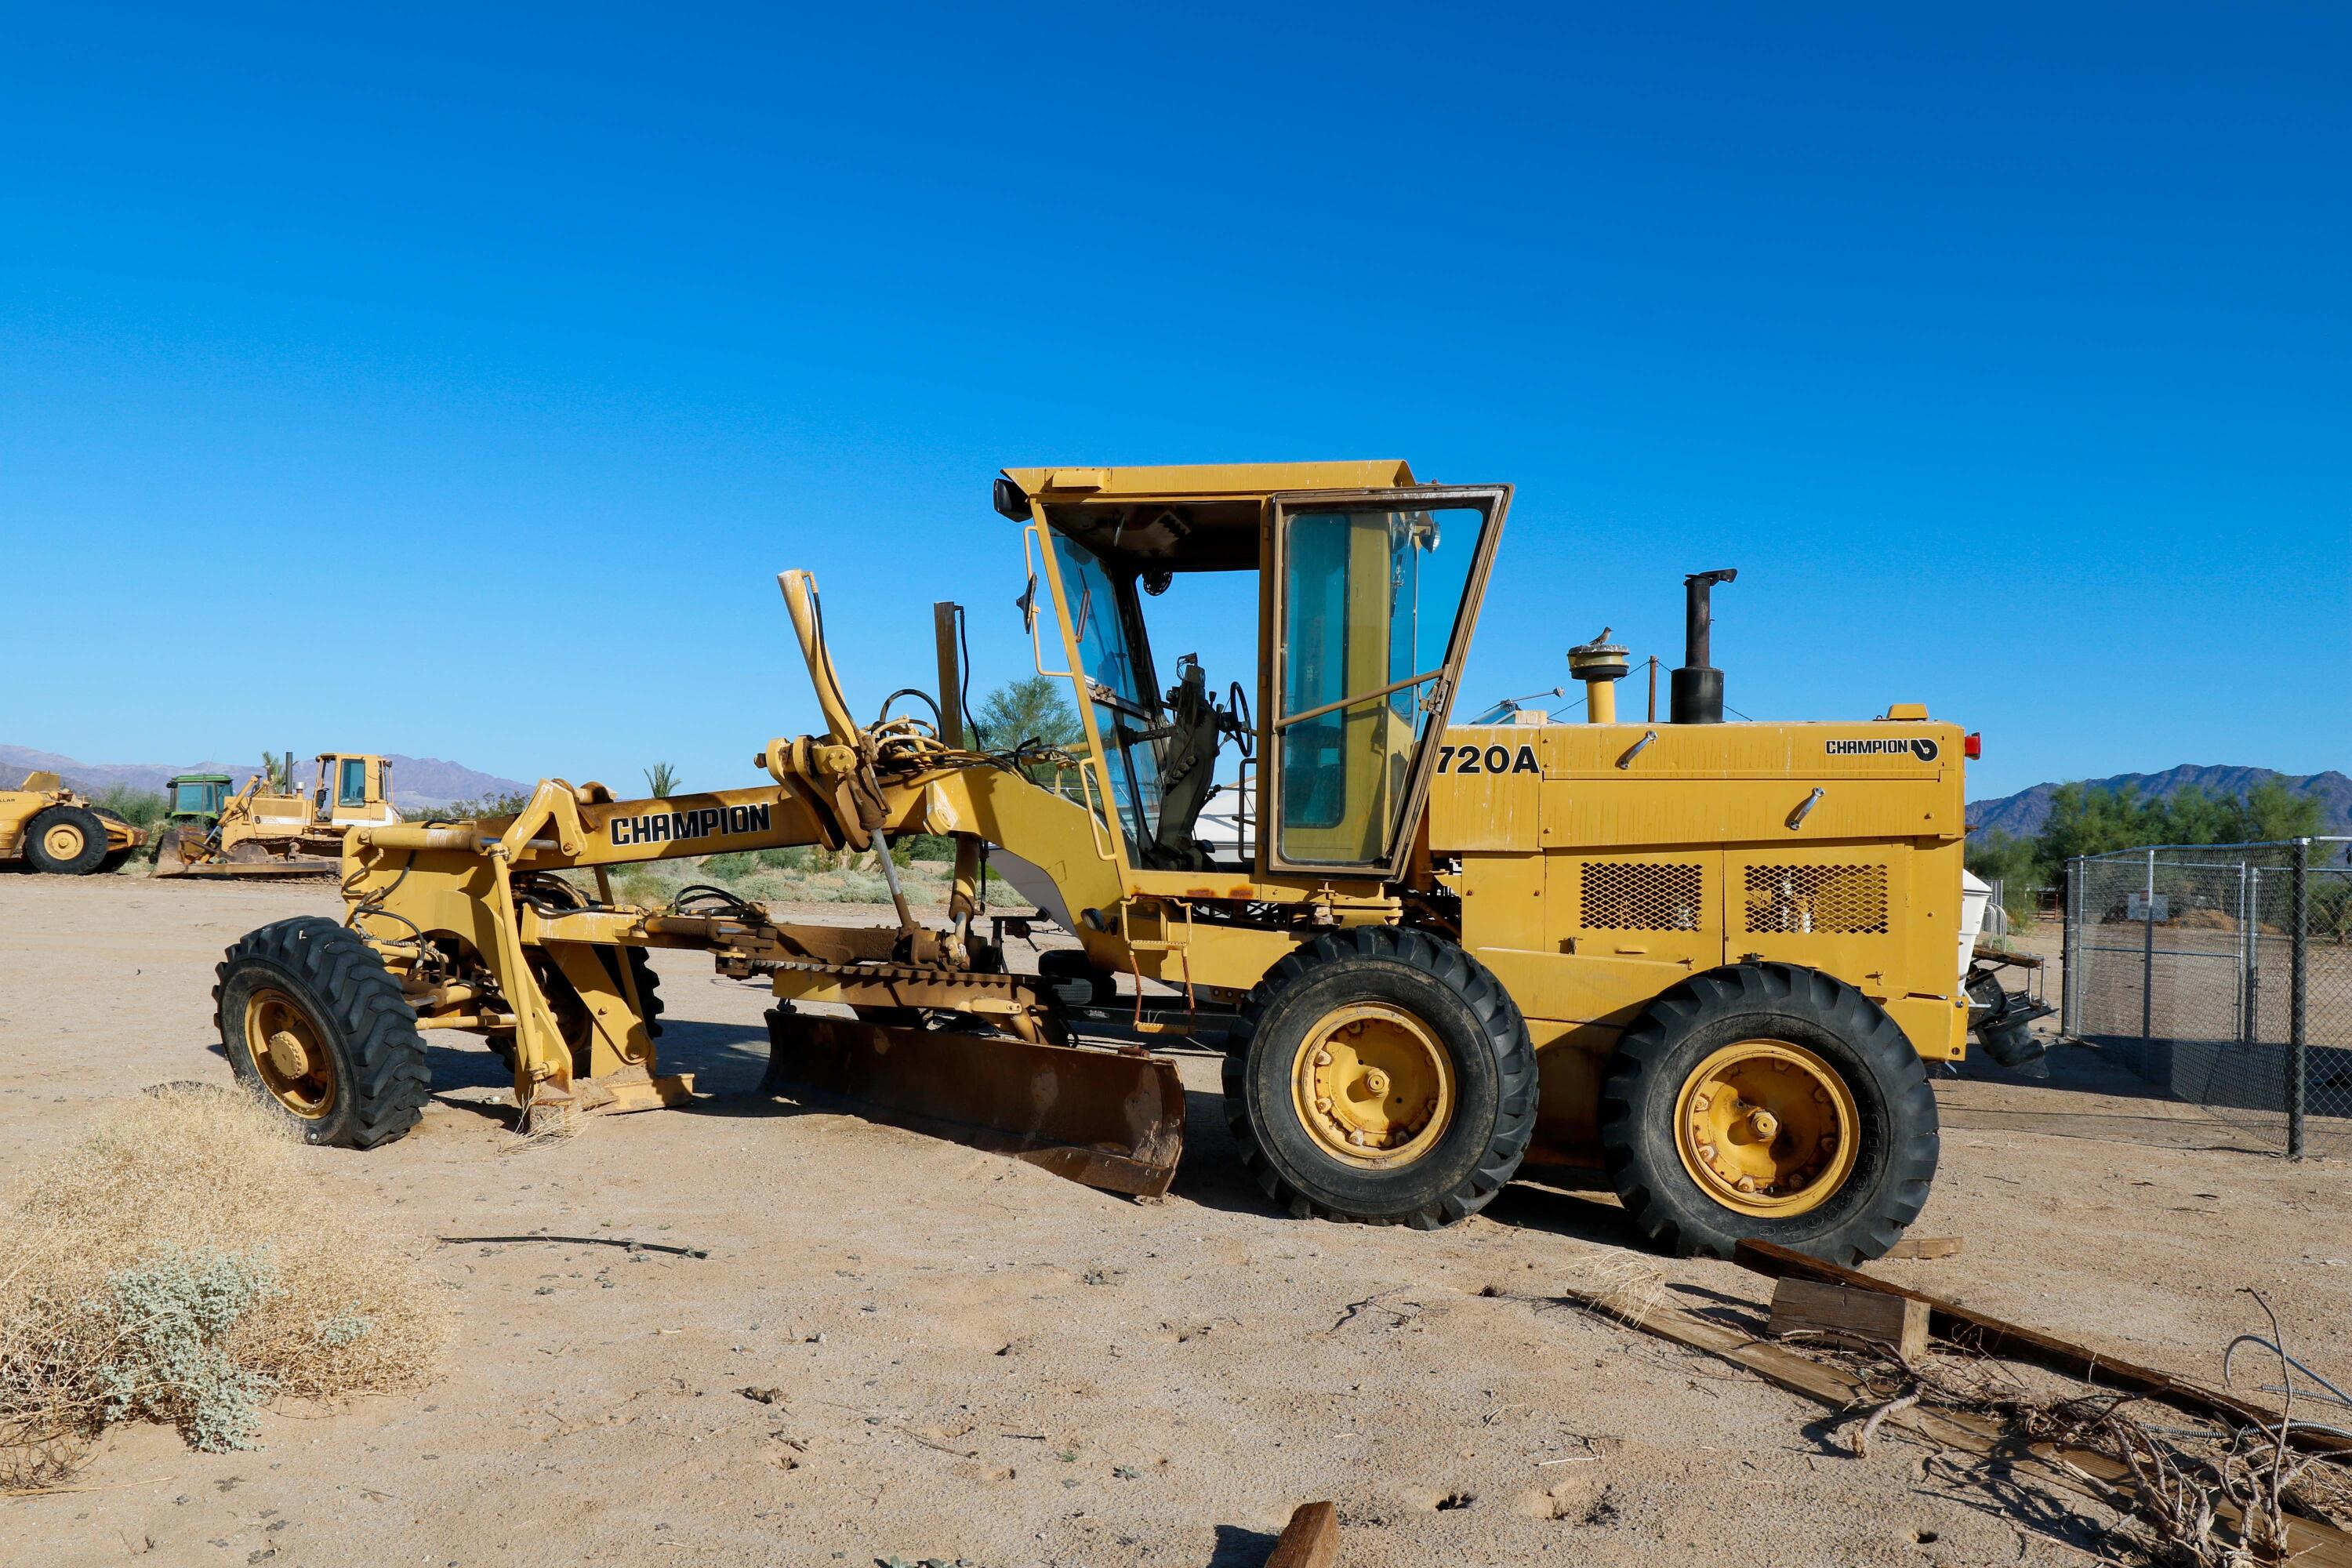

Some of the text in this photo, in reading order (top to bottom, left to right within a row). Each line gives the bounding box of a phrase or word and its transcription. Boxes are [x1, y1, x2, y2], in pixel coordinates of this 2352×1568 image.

[1436, 745, 1540, 774] 720A
[1826, 739, 1908, 754] CHAMPION
[610, 802, 771, 846] CHAMPION
